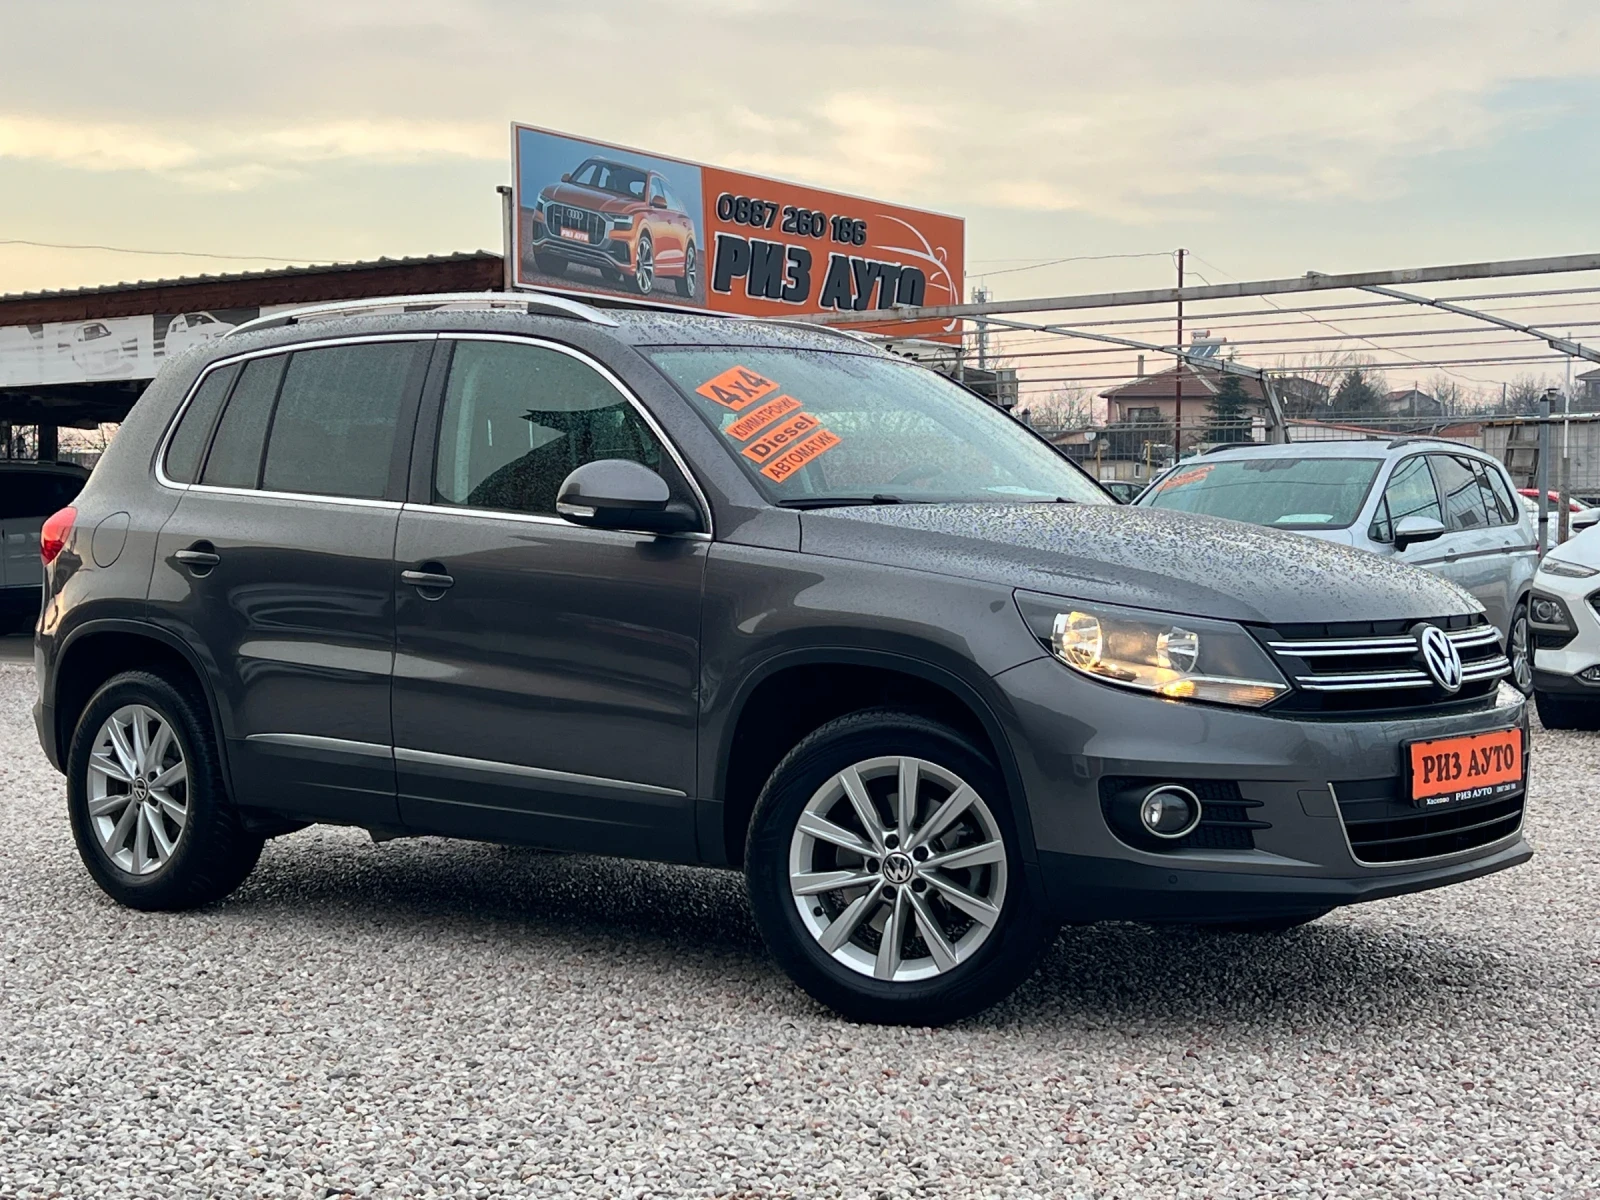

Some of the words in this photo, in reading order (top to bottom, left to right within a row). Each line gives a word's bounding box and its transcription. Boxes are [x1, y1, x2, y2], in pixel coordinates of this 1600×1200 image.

[716, 192, 779, 230] 0887
[781, 205, 826, 239] 260
[830, 214, 867, 246] 186
[712, 231, 812, 305] РИЗ
[818, 252, 926, 312] АУТО
[732, 397, 797, 438] КЛИМАТРОНИК
[750, 415, 814, 458] Diesel
[768, 431, 836, 479] АВТОМАТИК
[1422, 752, 1462, 783] РИЗ
[1467, 743, 1514, 777] АУТО
[1455, 790, 1471, 801] РИЗ
[1472, 787, 1492, 798] АУТО
